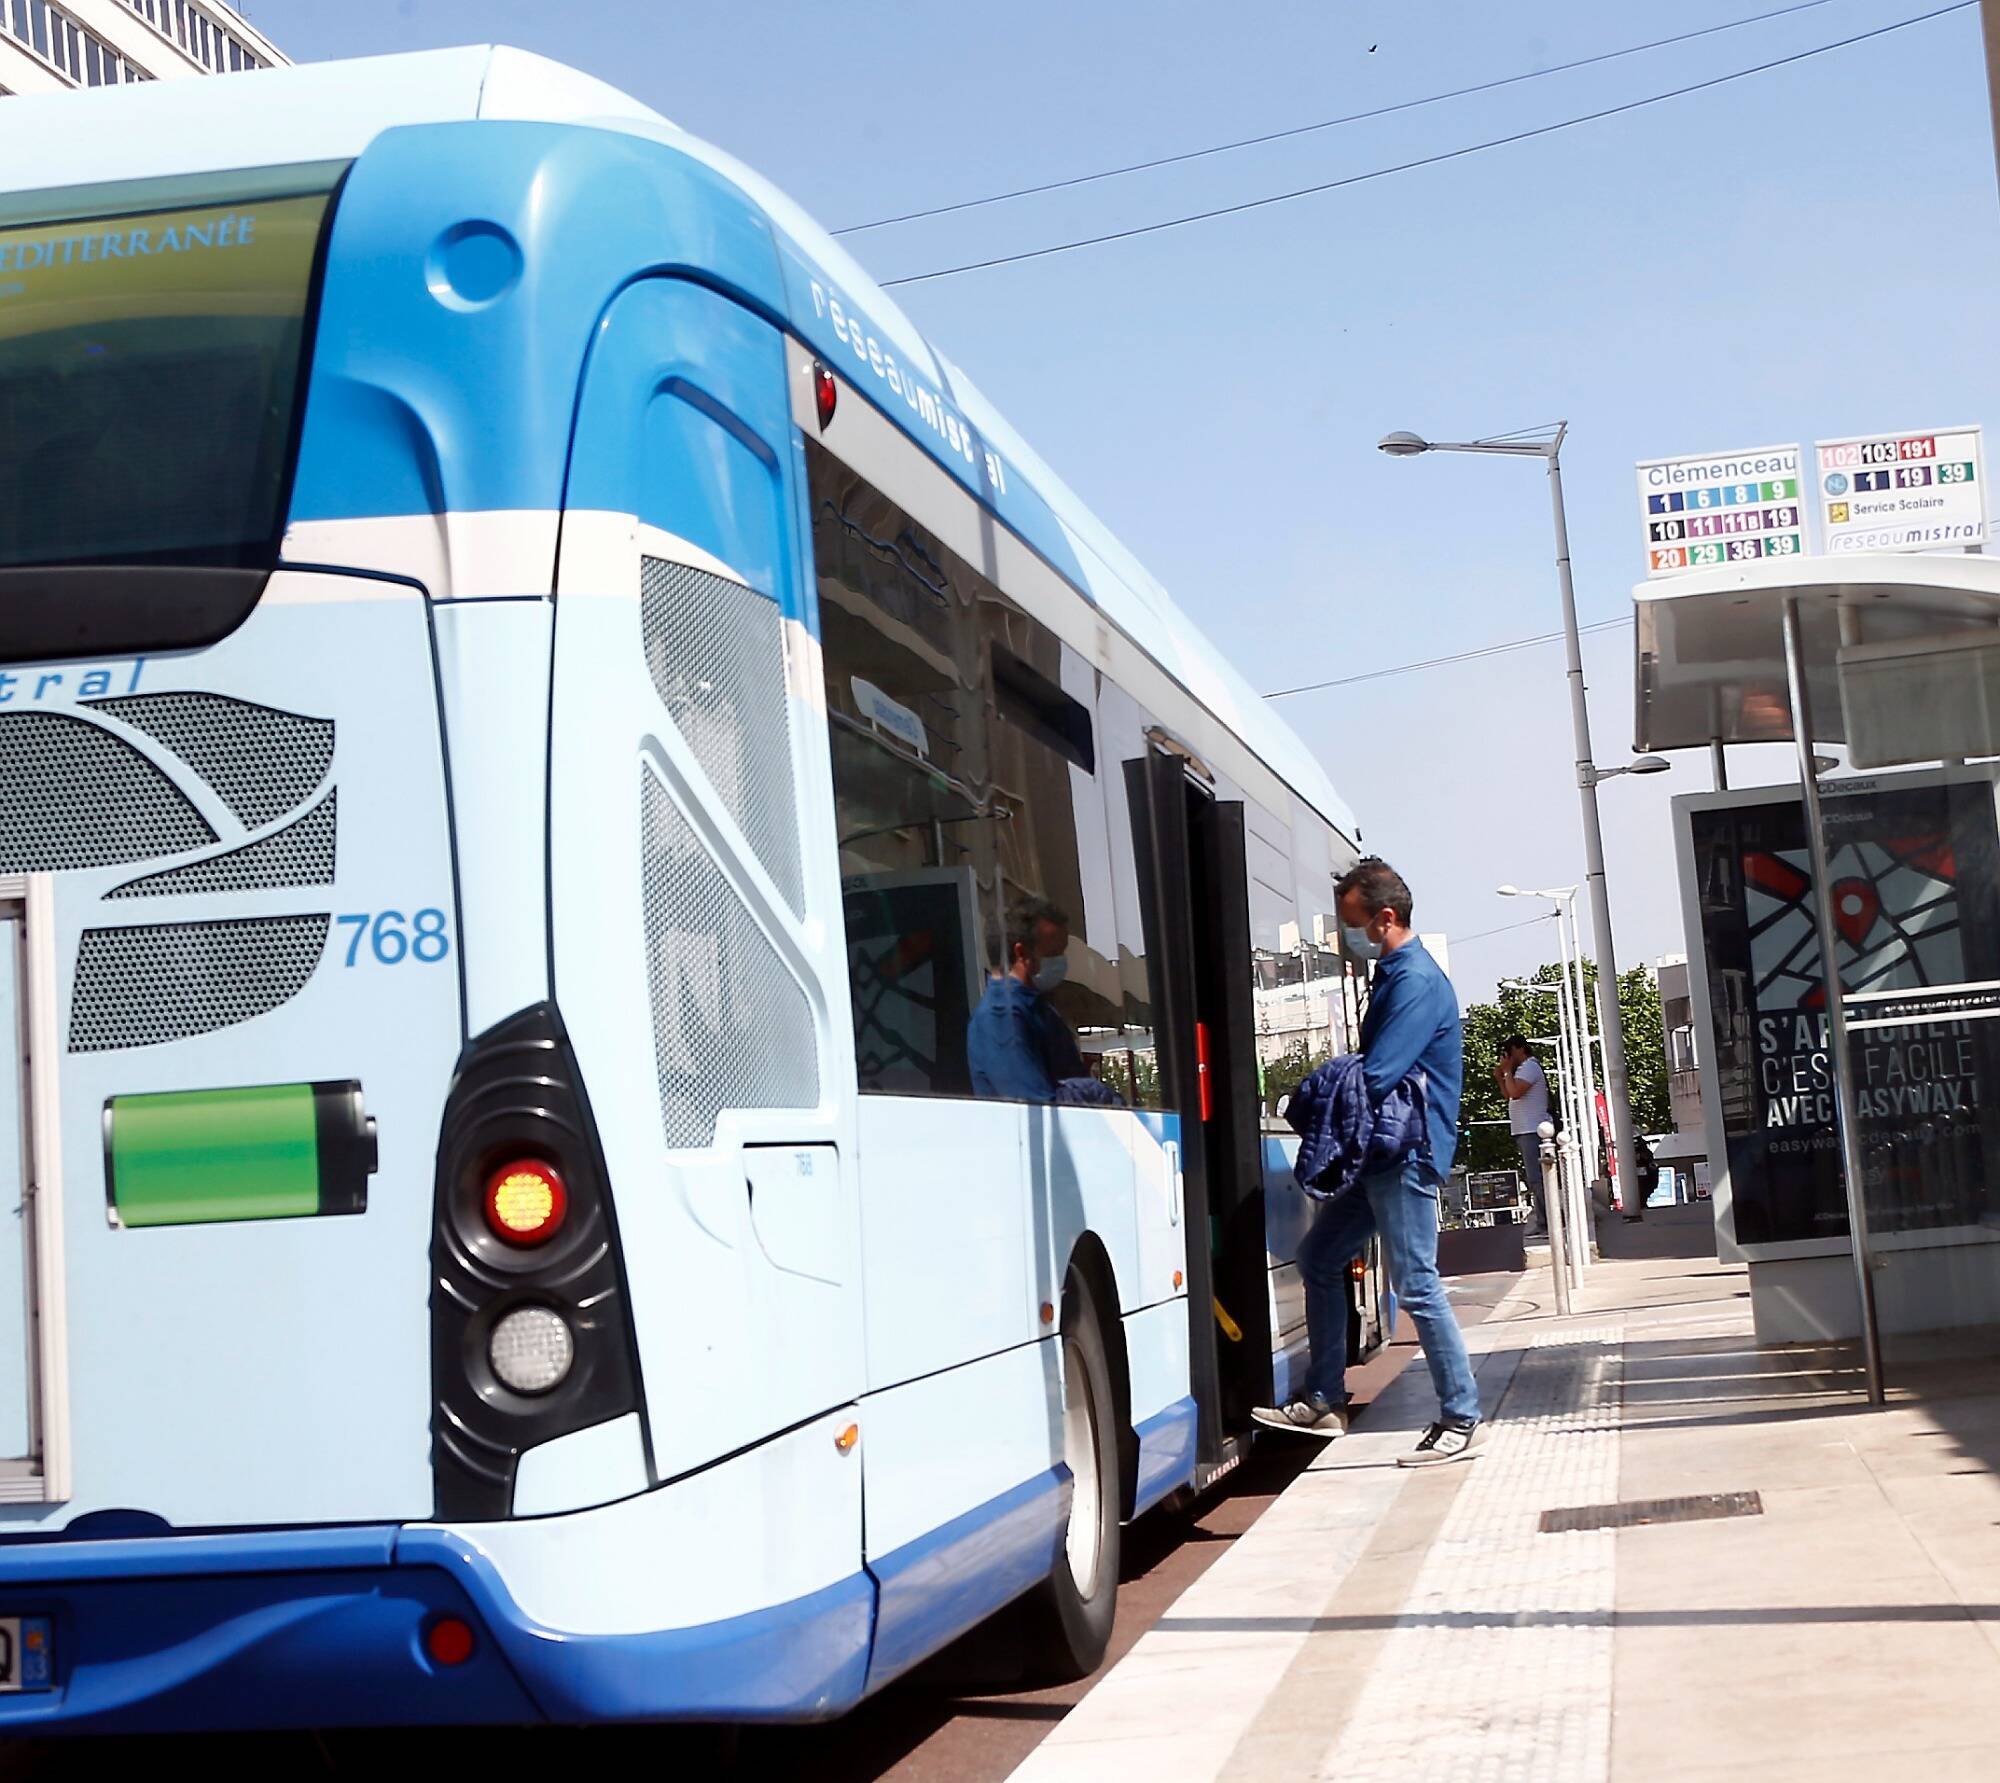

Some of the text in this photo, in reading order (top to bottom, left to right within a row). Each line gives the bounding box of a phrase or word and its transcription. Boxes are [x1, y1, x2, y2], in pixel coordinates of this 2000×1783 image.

[1824, 440, 1932, 467] 102 103 191
[1648, 456, 1797, 486] Clémenceau
[1866, 472, 1877, 491] 1
[1900, 468, 1923, 487] 19
[1941, 463, 1966, 483] 39
[1660, 481, 1785, 512] 1 6 8 9
[1853, 497, 1945, 515] Service Scolaire
[1656, 521, 1679, 541] 10
[1693, 517, 1716, 537] 11
[1768, 508, 1791, 528] 19
[1656, 536, 1793, 569] 20 29 36 39
[1817, 781, 1877, 794] CDecaux
[337, 908, 449, 968] 768
[1762, 1039, 1976, 1094] C'ES FACILE
[1766, 1093, 1832, 1128] AVEC
[1856, 1081, 1962, 1119] ASYWAY
